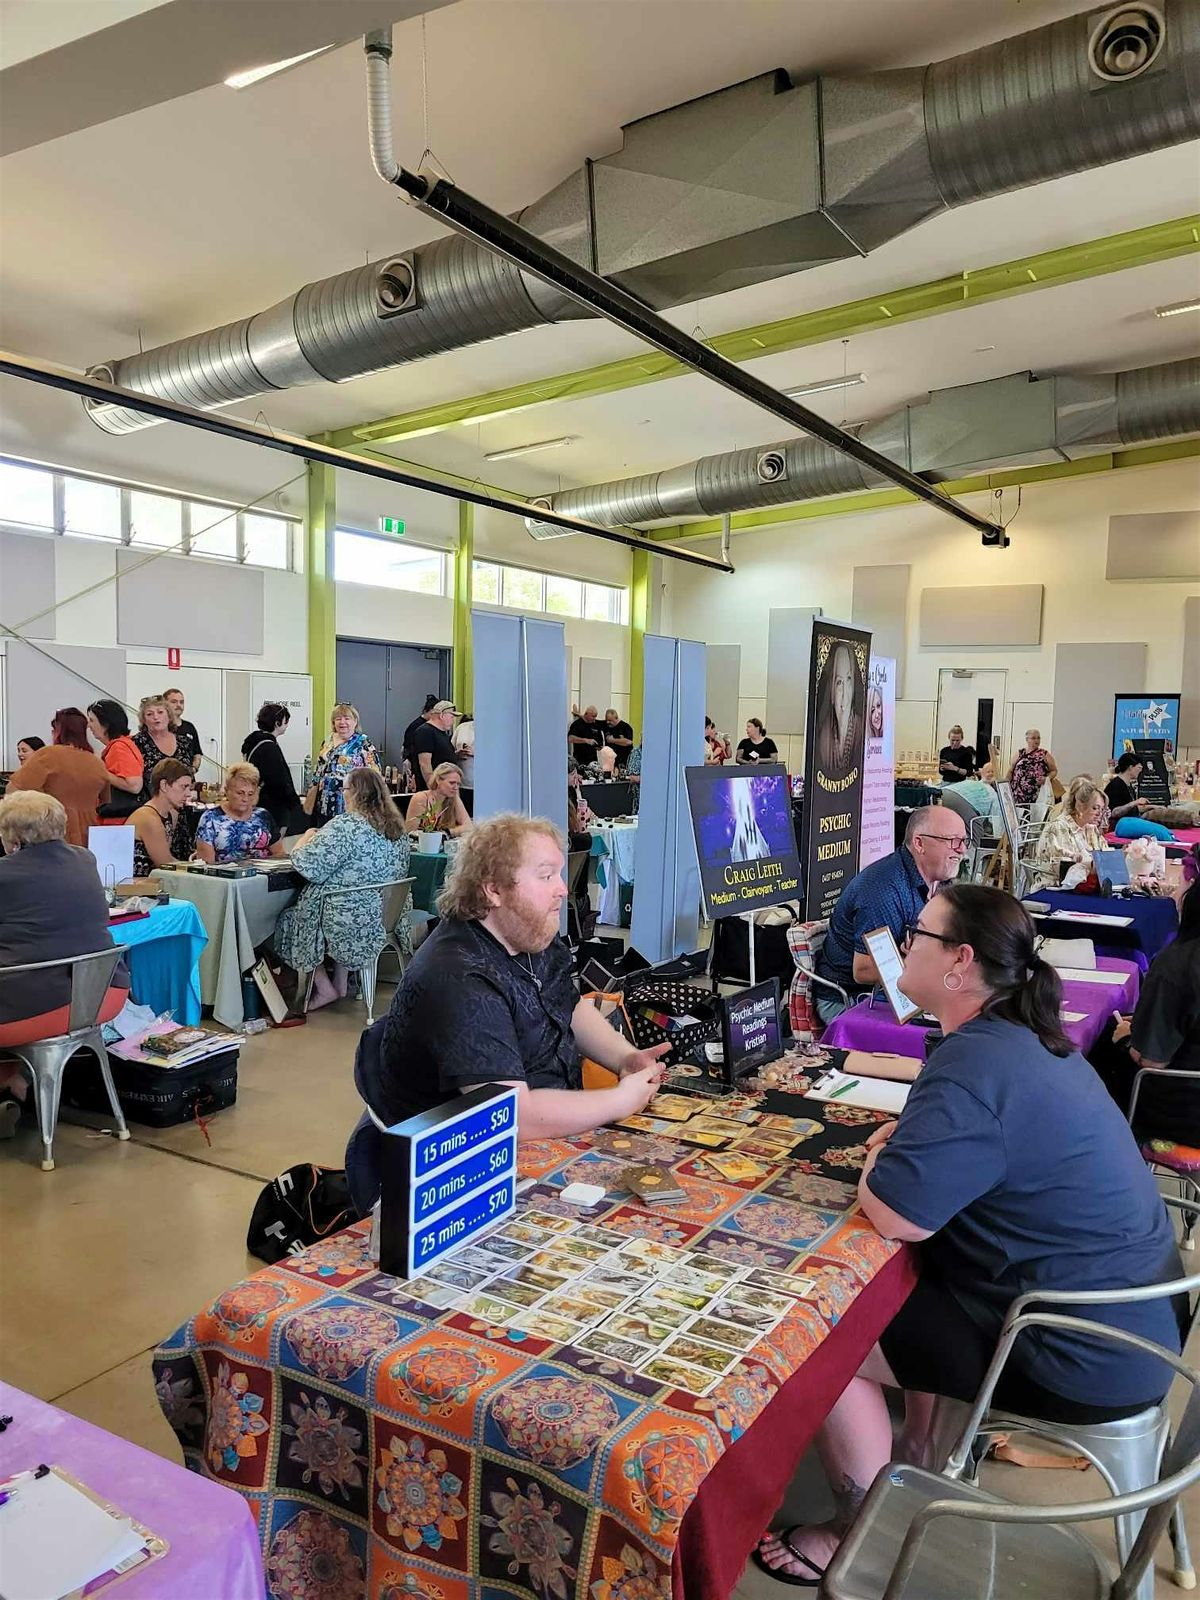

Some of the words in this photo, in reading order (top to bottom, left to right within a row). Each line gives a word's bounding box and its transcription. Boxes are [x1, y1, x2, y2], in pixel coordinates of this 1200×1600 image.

[1148, 706, 1163, 721] PLUS
[816, 770, 841, 793] GRANNY
[840, 767, 858, 792] BOHO
[819, 812, 852, 833] PSYCHIC
[817, 839, 851, 862] MEDIUM
[724, 865, 756, 886] CRAIG
[756, 861, 783, 879] LEITH
[710, 890, 737, 905] Medium
[741, 884, 774, 899] Clairvoyant
[777, 878, 798, 890] Teacher
[730, 1005, 753, 1024] Psychic
[753, 997, 775, 1014] Medium
[742, 1016, 767, 1036] Readings
[745, 1033, 767, 1051] Kristian
[423, 1142, 437, 1164] 15
[440, 1130, 468, 1156] mins
[490, 1106, 510, 1131] $50
[421, 1187, 436, 1211] 20
[439, 1173, 466, 1200] mins
[489, 1147, 509, 1173] $60
[420, 1232, 435, 1257] 25
[438, 1216, 466, 1243] mins
[488, 1188, 508, 1214] $70
